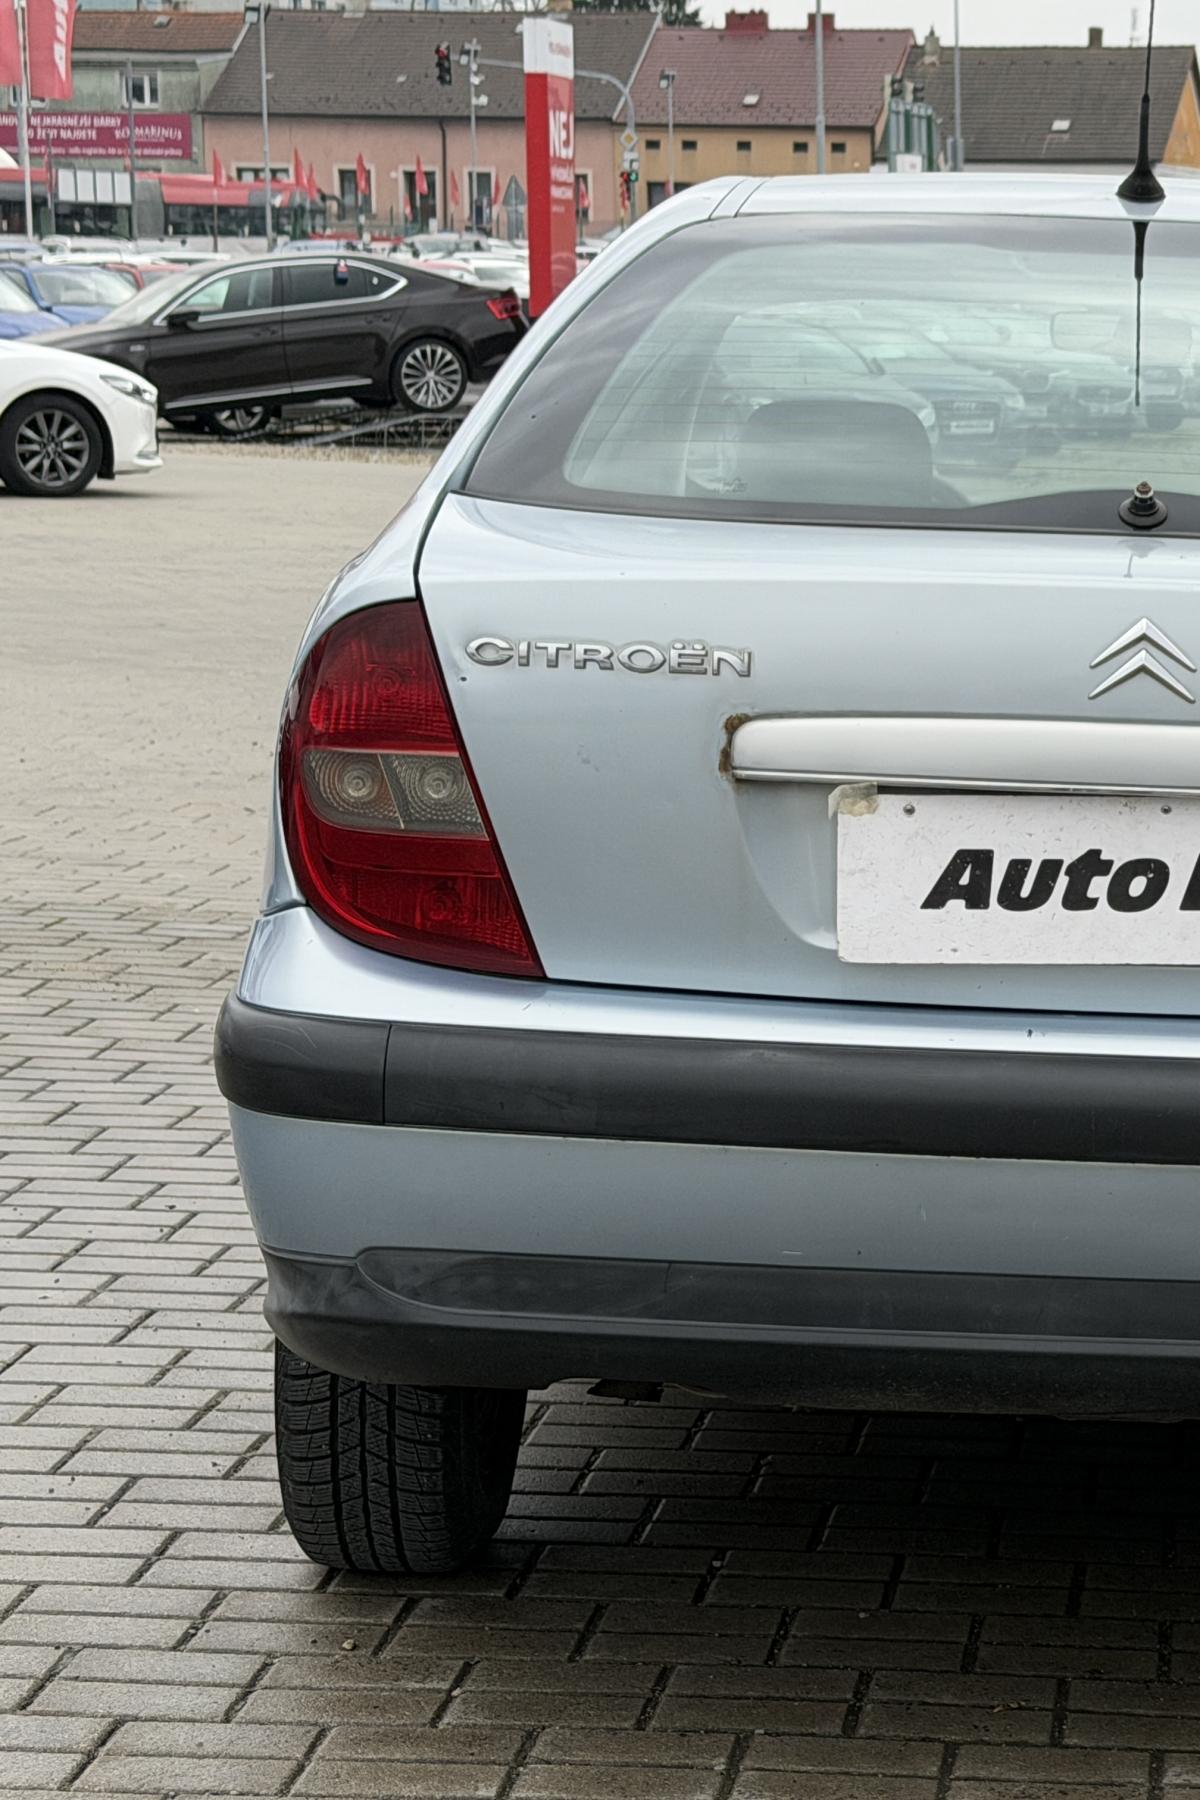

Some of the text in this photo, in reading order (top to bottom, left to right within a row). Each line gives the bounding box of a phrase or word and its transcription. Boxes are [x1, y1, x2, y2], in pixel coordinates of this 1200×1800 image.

[549, 109, 574, 161] NEJ
[465, 637, 753, 678] CITROËN
[920, 848, 1171, 913] Auto
